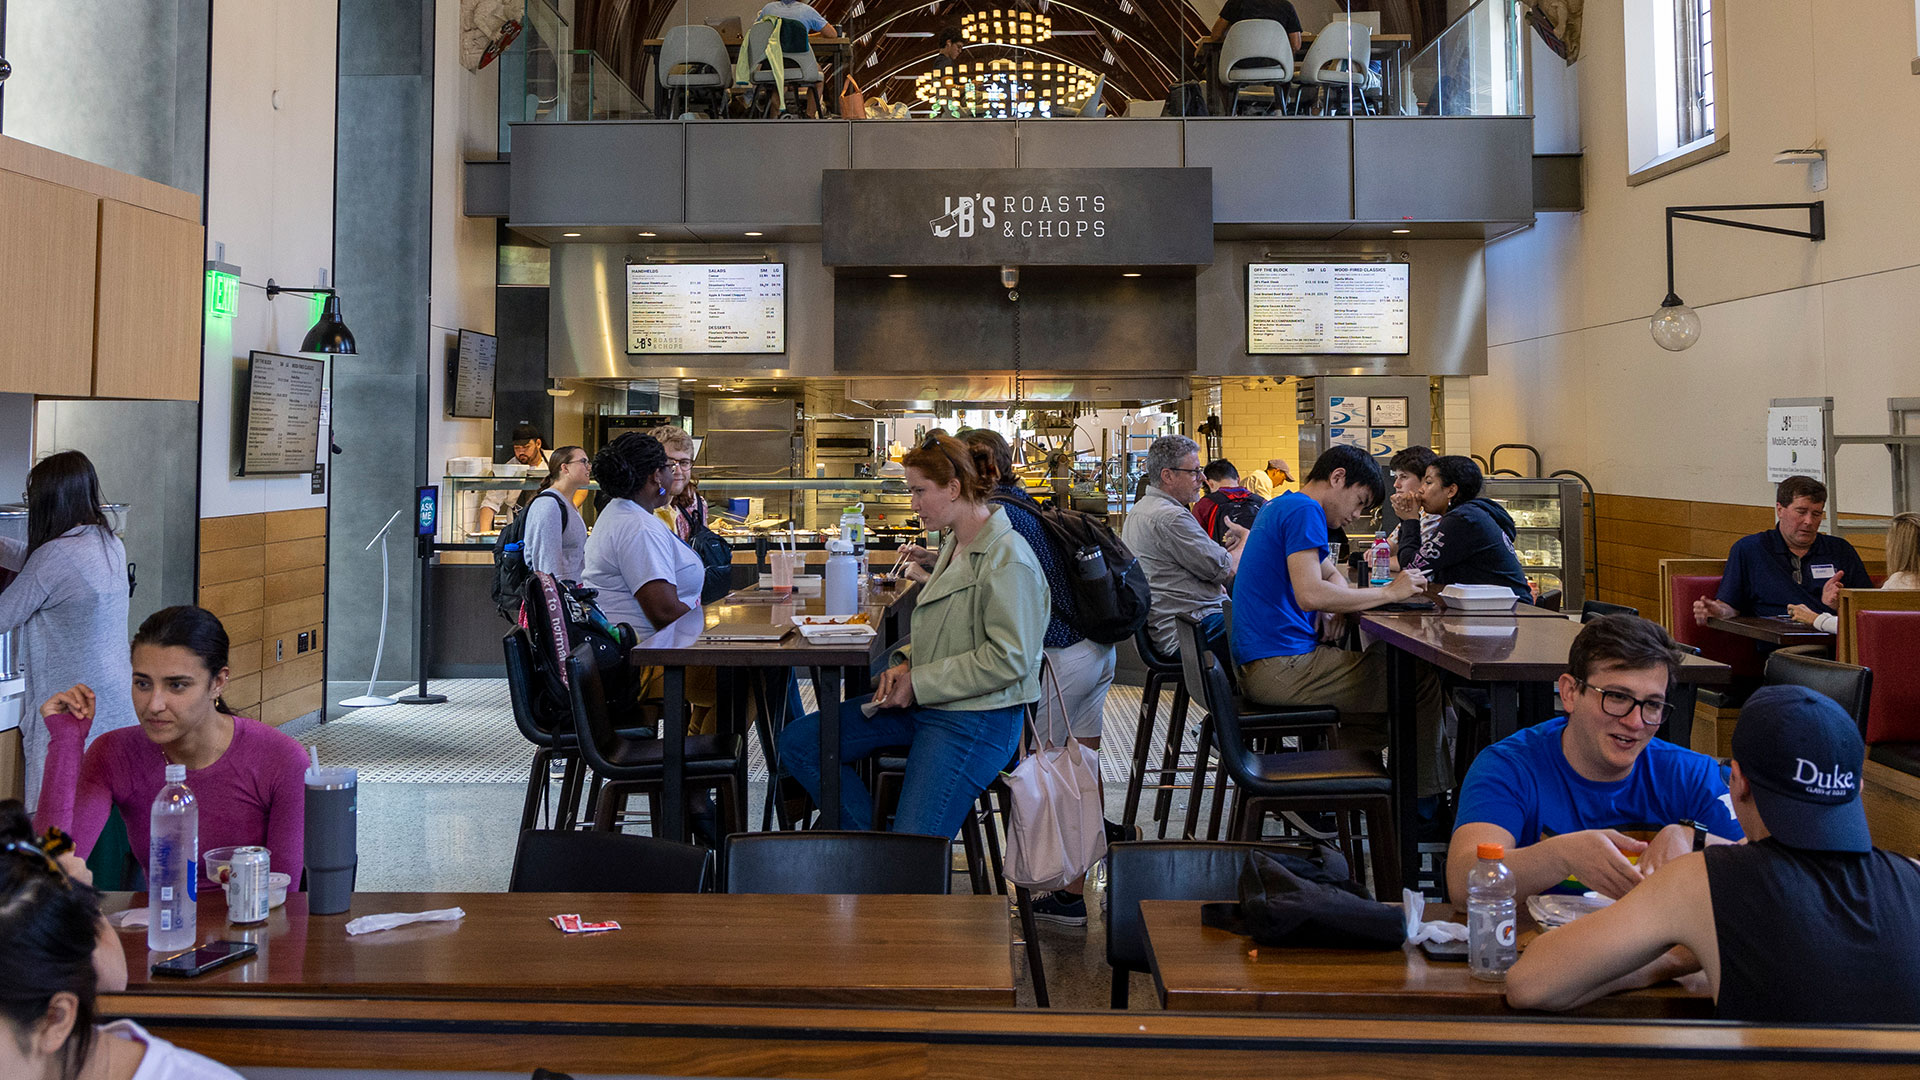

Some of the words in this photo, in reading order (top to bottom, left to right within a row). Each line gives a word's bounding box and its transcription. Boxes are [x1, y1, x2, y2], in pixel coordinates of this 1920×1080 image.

[930, 193, 996, 238] JB'S
[1003, 195, 1105, 213] ROASTS
[1003, 220, 1105, 238] &CHOPS
[216, 276, 238, 312] EXIT
[1772, 436, 1786, 446] Mobile
[1787, 436, 1799, 446] Order
[1799, 436, 1818, 448] Pick-Up
[421, 503, 433, 511] ASK
[422, 511, 431, 520] ME
[547, 597, 558, 612] to
[1792, 758, 1854, 789] Duke
[1805, 786, 1825, 795] CLASS
[1495, 918, 1515, 947] G
